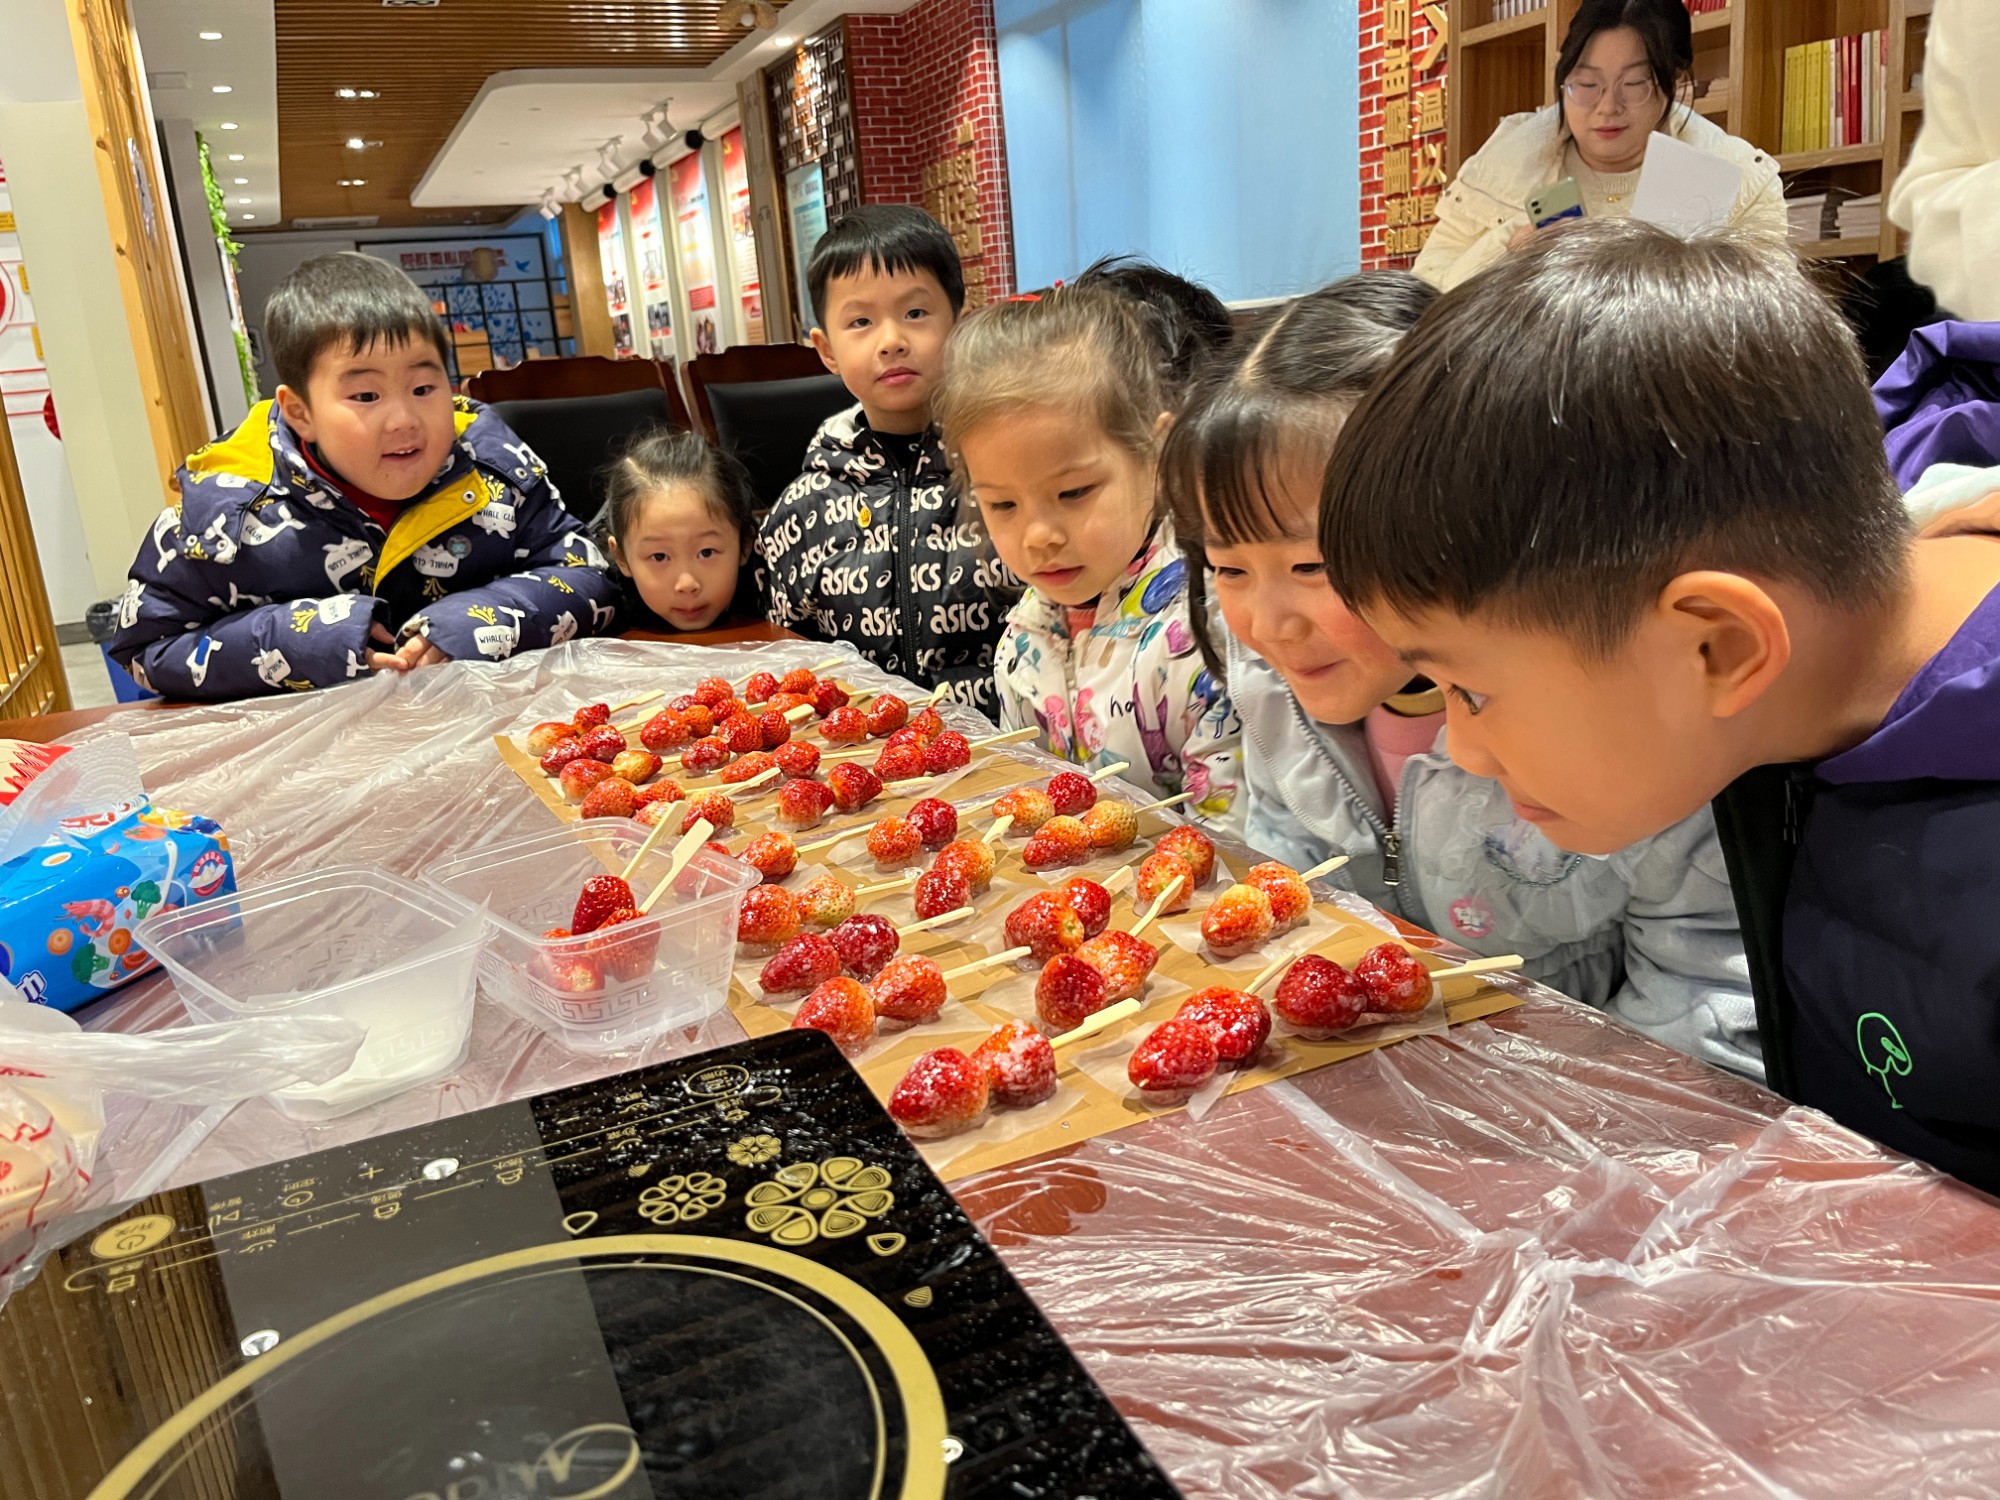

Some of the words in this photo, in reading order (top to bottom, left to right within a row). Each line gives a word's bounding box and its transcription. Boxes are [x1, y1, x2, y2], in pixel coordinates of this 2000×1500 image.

[503, 511, 516, 523] CLU
[245, 525, 263, 541] CLUB
[764, 513, 802, 563] asics
[863, 524, 899, 555] asic
[926, 521, 982, 553] asics
[328, 558, 347, 571] CLUB
[431, 560, 455, 570] WHALE
[820, 565, 870, 596] asics
[860, 606, 903, 637] asic
[930, 602, 990, 635] asics
[478, 633, 503, 644] WHALE
[114, 1221, 155, 1236] 开/关
